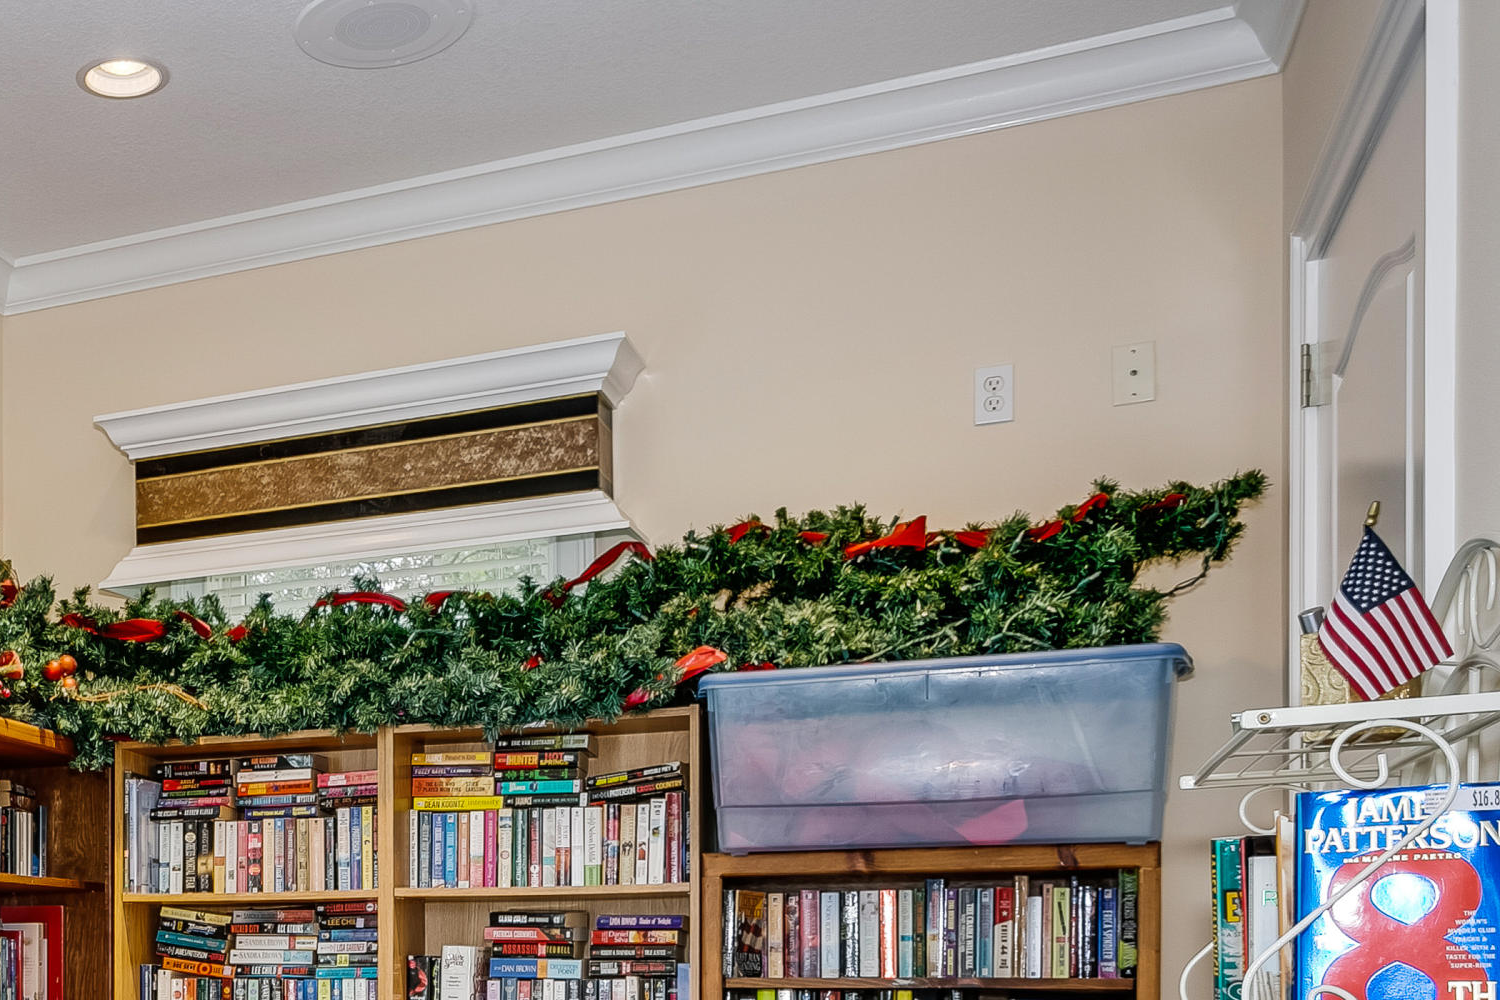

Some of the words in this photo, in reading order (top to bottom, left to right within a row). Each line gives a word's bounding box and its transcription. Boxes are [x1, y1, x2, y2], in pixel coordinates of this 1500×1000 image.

[507, 753, 538, 766] HUNTER
[544, 752, 565, 761] HOT
[424, 800, 440, 809] DEAN
[441, 799, 465, 809] KOONTZ
[1304, 820, 1500, 855] PATTERSON
[1122, 894, 1136, 920] ROBERTS
[1102, 910, 1113, 929] ERICA
[502, 944, 538, 956] ASSASSIN
[1102, 929, 1113, 960] SPINDLER
[501, 966, 513, 974] DAN
[515, 965, 537, 974] BROWN
